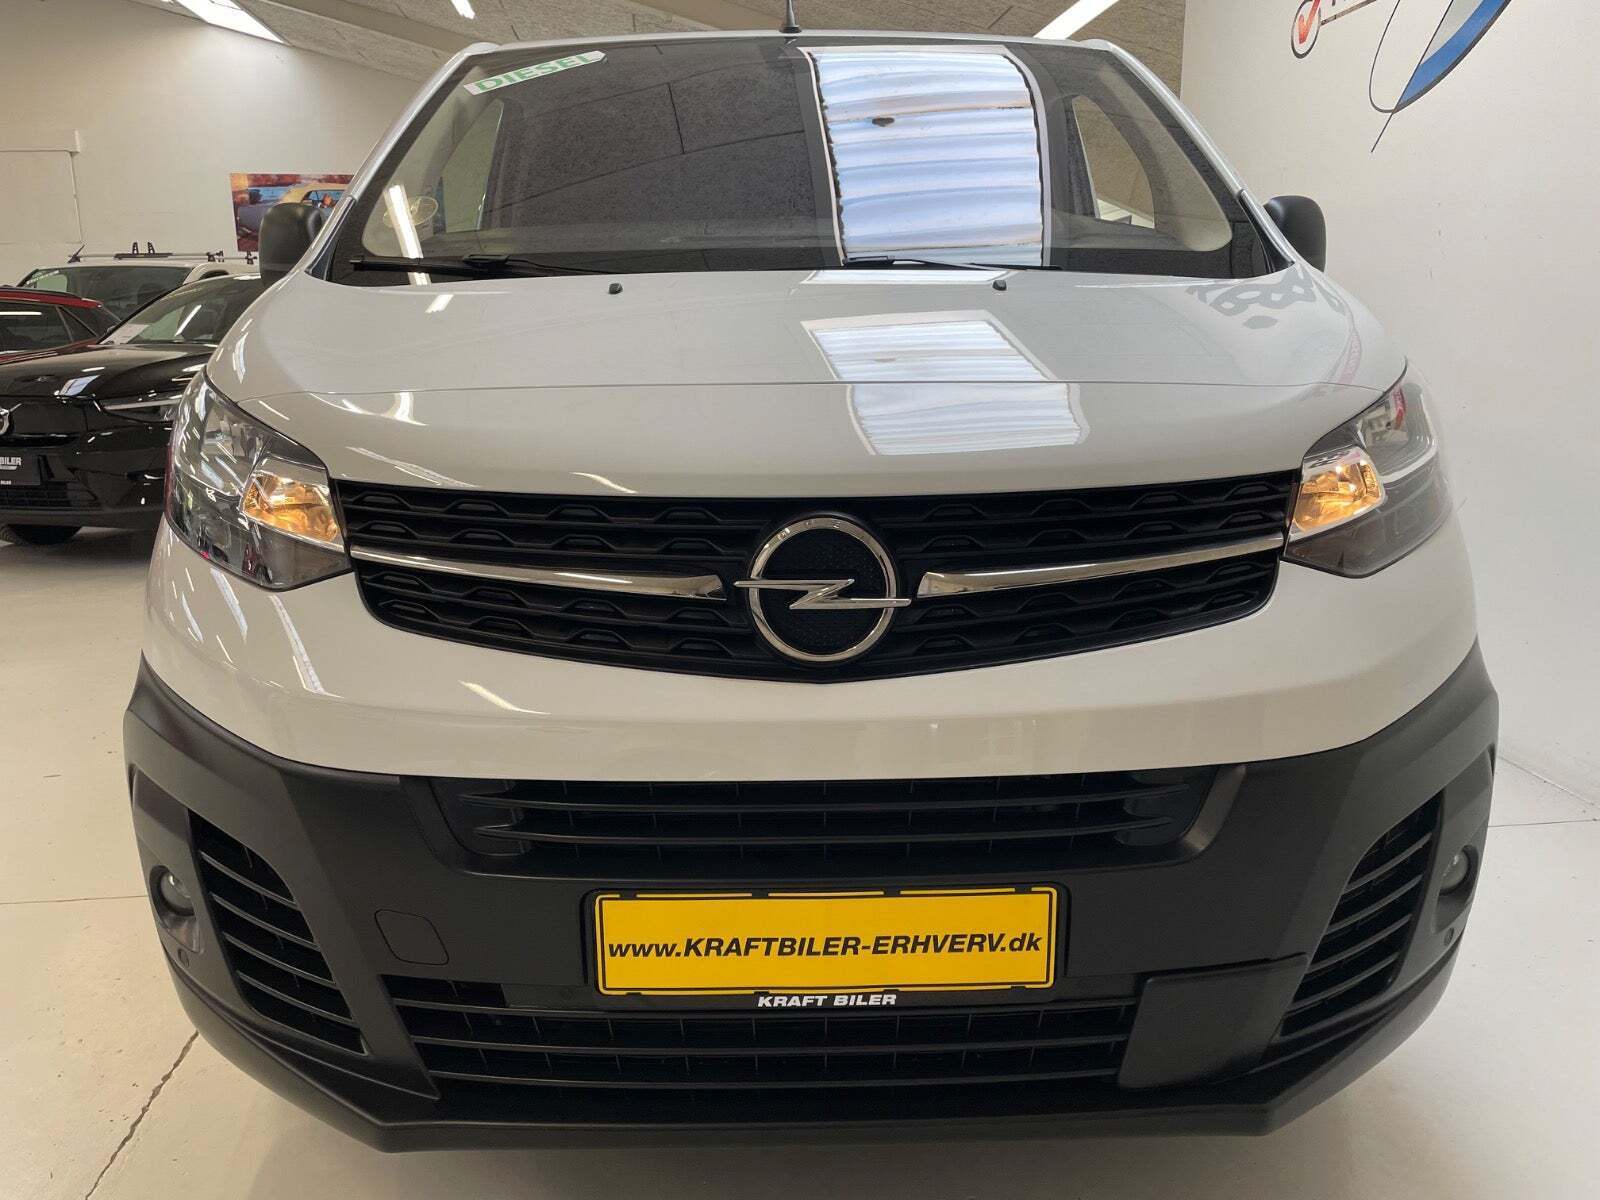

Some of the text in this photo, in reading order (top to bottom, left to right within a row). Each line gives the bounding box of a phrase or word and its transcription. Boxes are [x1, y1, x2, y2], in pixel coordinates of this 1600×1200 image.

[608, 932, 1042, 958] www.KRAFTBILER-ERHVERV.dk
[757, 994, 897, 1008] KRAFT BILER
